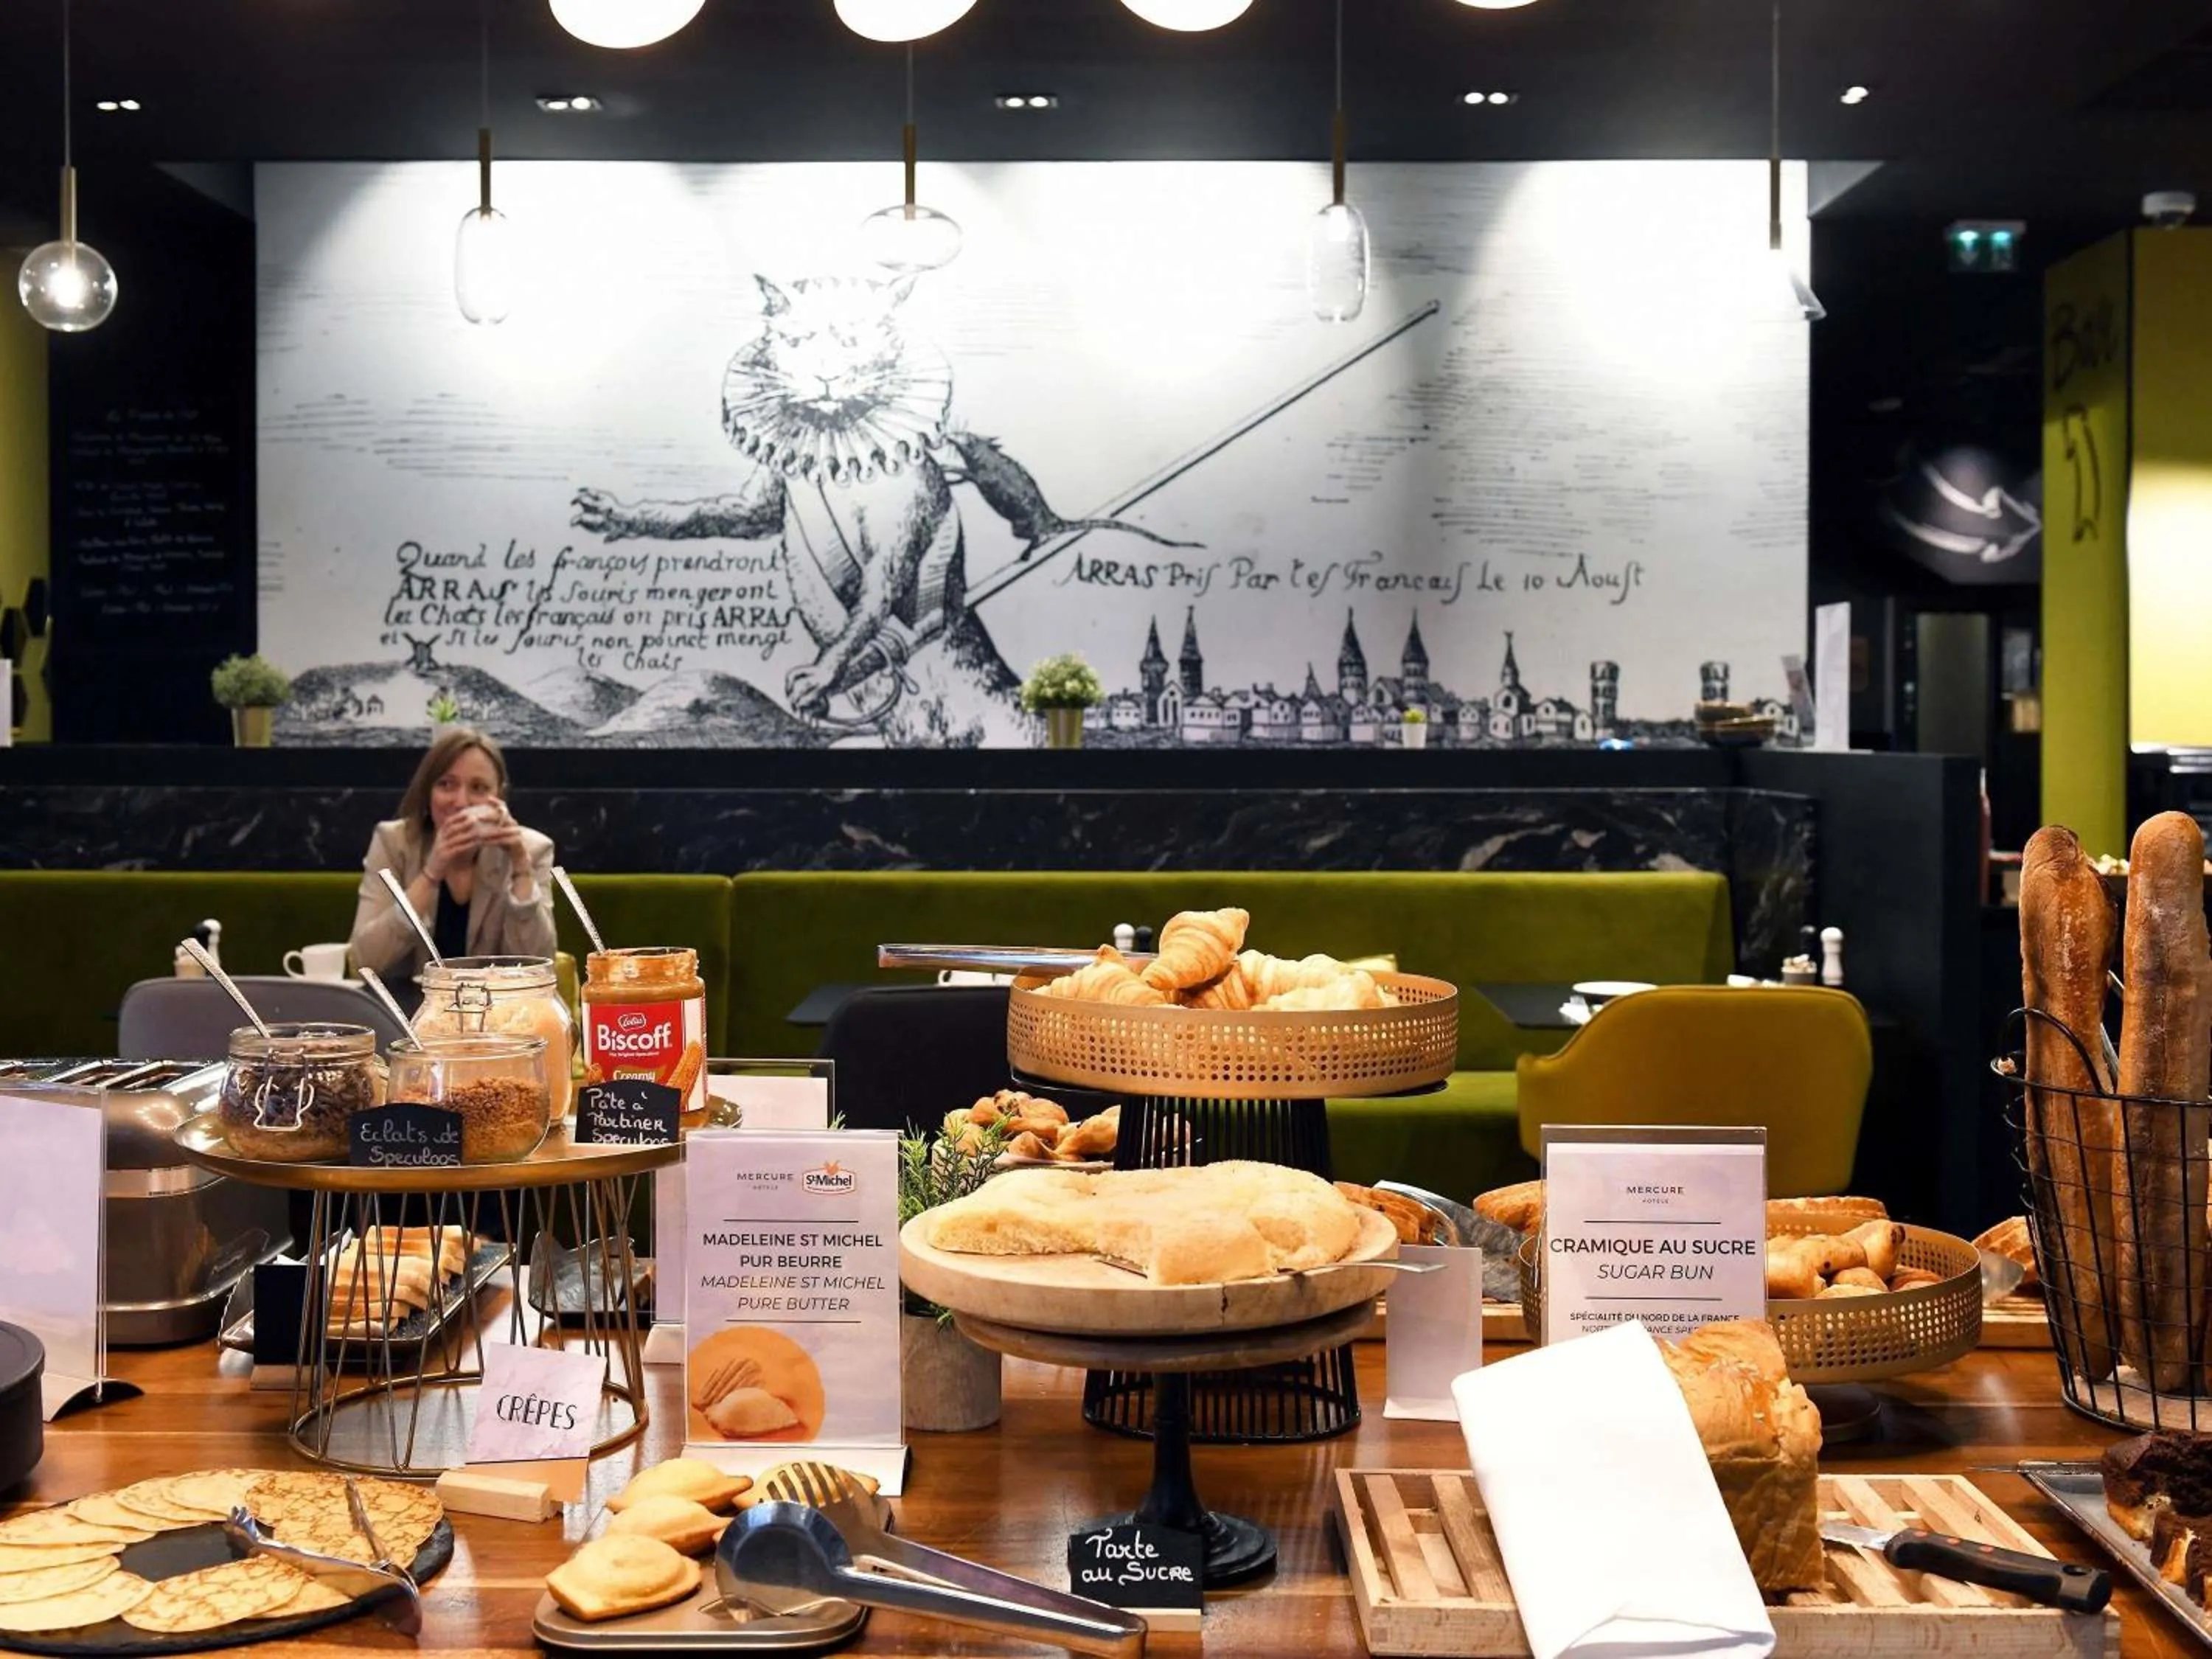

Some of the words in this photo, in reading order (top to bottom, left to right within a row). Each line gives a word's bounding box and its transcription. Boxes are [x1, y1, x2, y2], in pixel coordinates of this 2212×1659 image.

[396, 540, 487, 575] Quand
[504, 538, 535, 569] les
[653, 549, 780, 585] prendront
[1051, 552, 1159, 589] ARRAS
[1228, 556, 1280, 591] Par
[1478, 560, 1505, 591] Le
[420, 602, 487, 627] Chats
[591, 633, 633, 650] non
[597, 1022, 672, 1051] Biscoff
[613, 1070, 656, 1082] Creamy
[586, 1087, 627, 1110] Pâte
[632, 1091, 649, 1110] à
[432, 1121, 460, 1144] de
[369, 1145, 462, 1168] Speculoos
[736, 1172, 794, 1181] MERCURE
[1626, 1186, 1685, 1195] MERCURE
[703, 1233, 796, 1247] MADELEINE
[799, 1234, 819, 1247] ST
[824, 1234, 883, 1248] MICHEL
[1550, 1238, 1655, 1256] CRAMIQUE
[1658, 1239, 1687, 1255] AU
[1691, 1239, 1756, 1256] SUCRE
[740, 1256, 773, 1268] PUR
[777, 1256, 843, 1269] BEURRE
[1597, 1264, 1666, 1280] SUGAR
[1669, 1265, 1714, 1280] BUN
[700, 1275, 796, 1289] MADELEINE
[801, 1276, 821, 1289] ST
[824, 1276, 886, 1290] MICHEL
[737, 1296, 783, 1310] PURE
[787, 1298, 851, 1311] BUTTER
[1641, 1313, 1670, 1322] NORD
[1672, 1314, 1685, 1322] DE
[1688, 1314, 1700, 1322] LA
[495, 1393, 577, 1430] CRÊPES
[1085, 1527, 1159, 1559] Tarte
[1081, 1567, 1113, 1583] au
